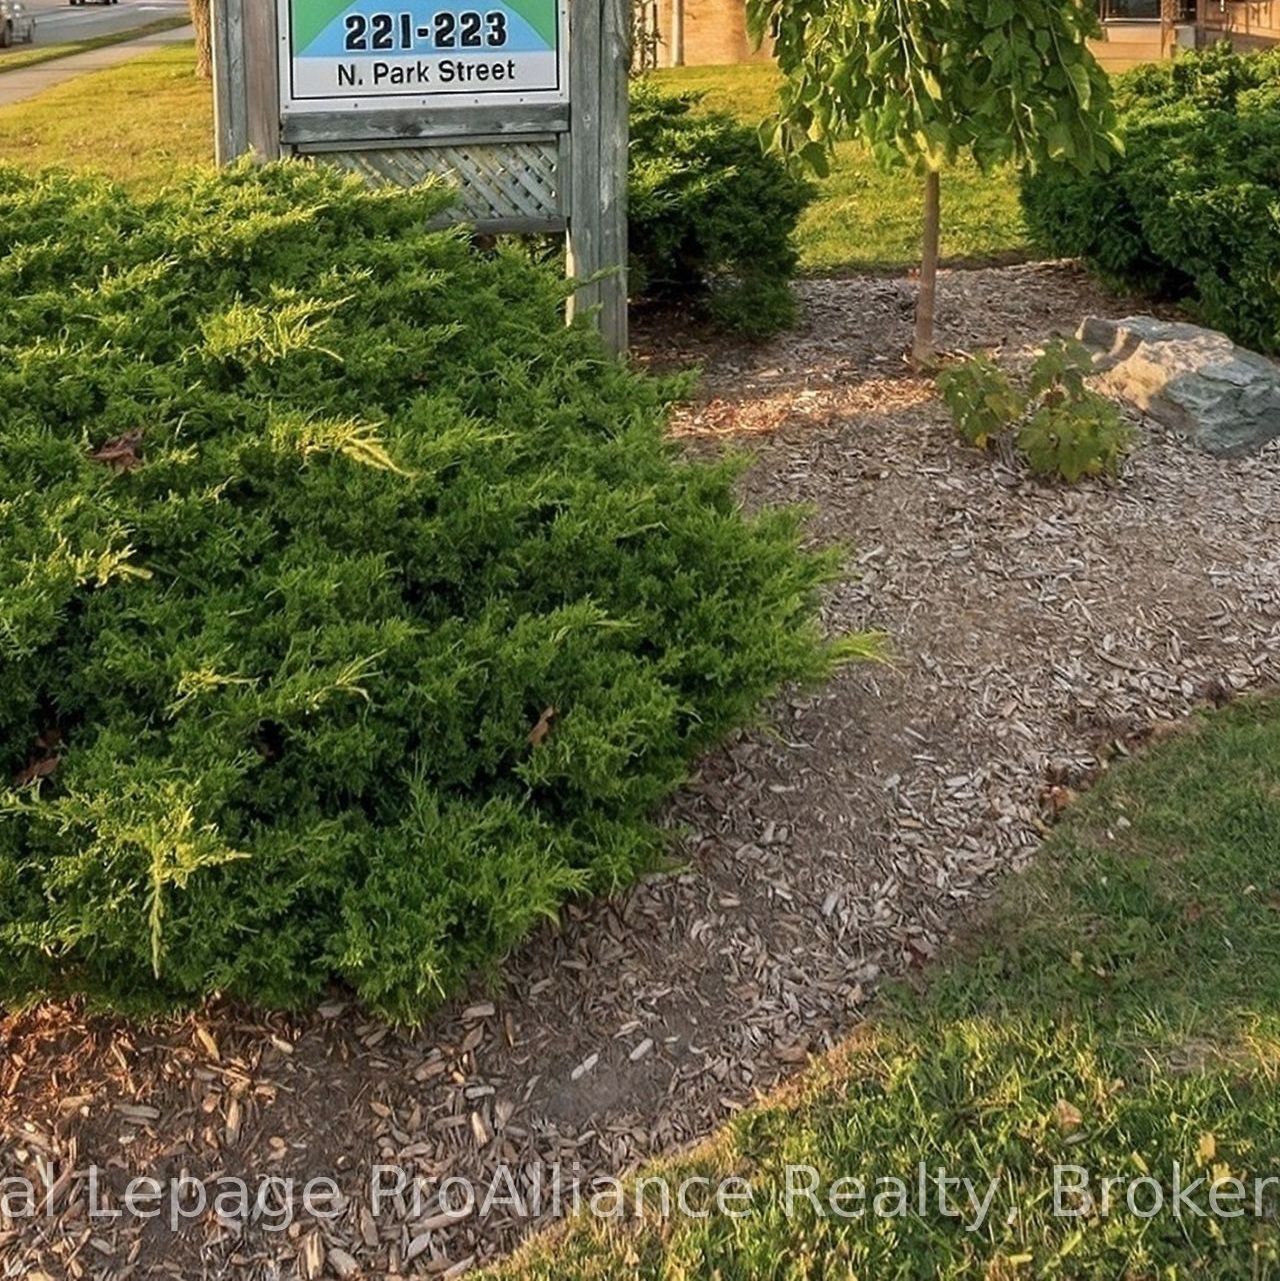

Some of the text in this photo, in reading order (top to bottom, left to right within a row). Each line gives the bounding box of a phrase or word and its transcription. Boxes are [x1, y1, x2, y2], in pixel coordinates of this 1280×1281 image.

[344, 11, 508, 51] 221-223
[337, 59, 516, 86] N. Park Street
